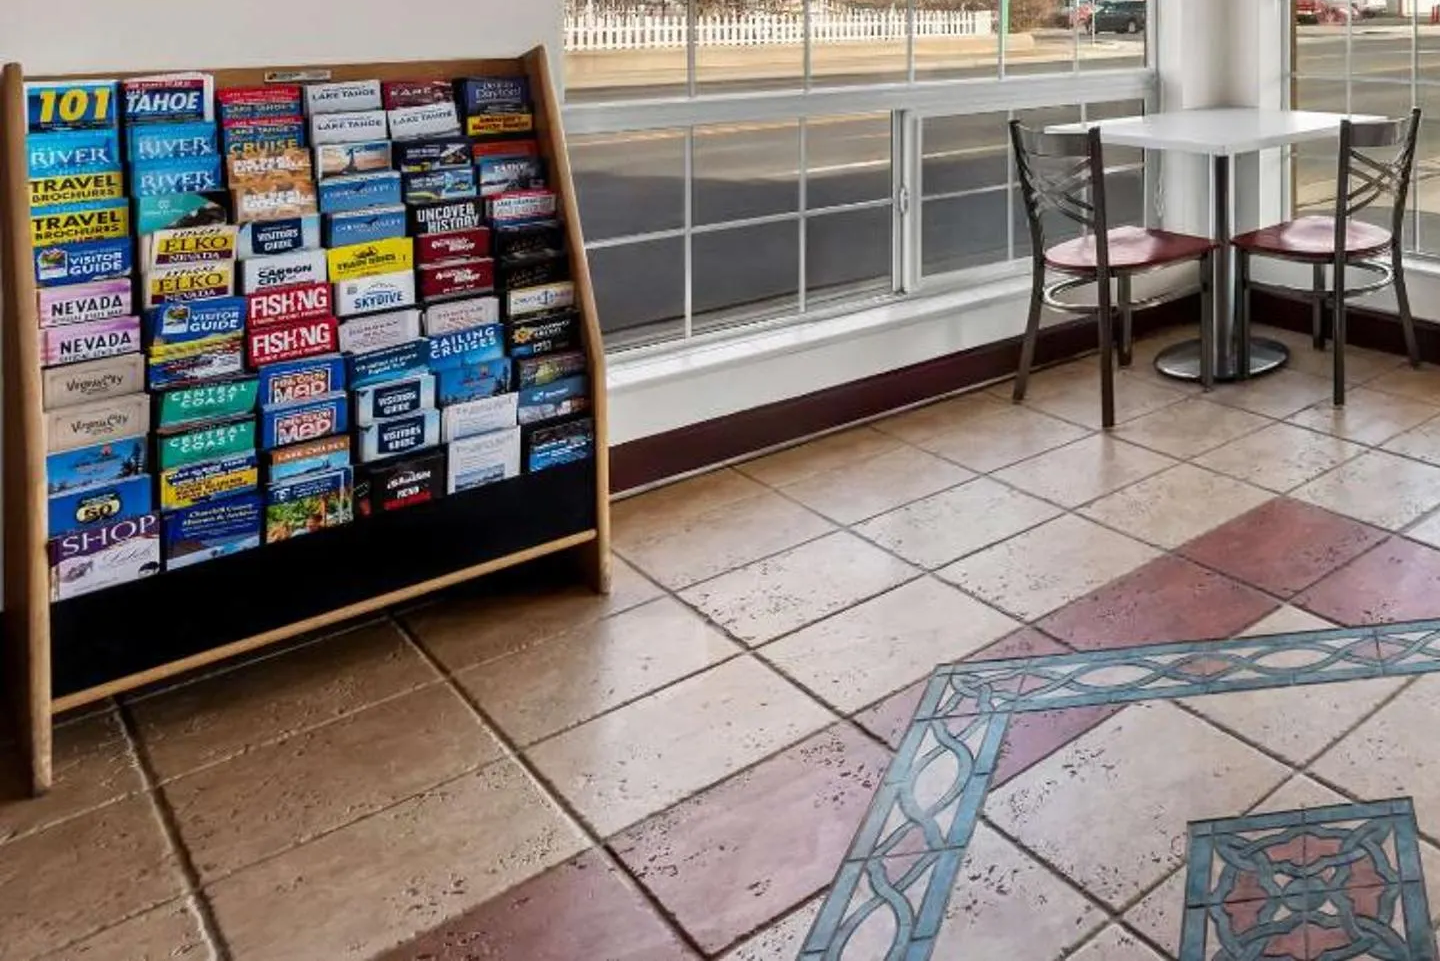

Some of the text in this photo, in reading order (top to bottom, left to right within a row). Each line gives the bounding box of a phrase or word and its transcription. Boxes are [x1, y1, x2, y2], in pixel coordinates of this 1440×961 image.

[40, 86, 110, 123] 101
[126, 92, 200, 114] TAHOE
[30, 148, 110, 168] RIVER
[29, 174, 118, 193] TRAVEL
[32, 188, 115, 203] BROCHURES
[32, 210, 121, 232] TRAVEL
[416, 202, 475, 223] UNCOVER
[35, 225, 120, 241] BROCHURES
[427, 214, 481, 235] HISTORY
[164, 237, 229, 253] ELKO
[68, 252, 123, 266] VISITOR
[68, 262, 123, 276] GUIDE
[158, 272, 224, 291] ELKO
[51, 295, 123, 317] NEVADA
[354, 290, 405, 310] SKYDIVE
[190, 319, 238, 332] GUIDE
[60, 331, 132, 355] NEVADA
[430, 327, 496, 349] SAILING
[430, 337, 498, 360] CRUISES
[171, 383, 247, 402] CENTRAL
[181, 393, 235, 408] COAST
[169, 425, 247, 448] CENTRAL
[181, 435, 236, 453] COAST
[62, 515, 156, 554] SHOP
